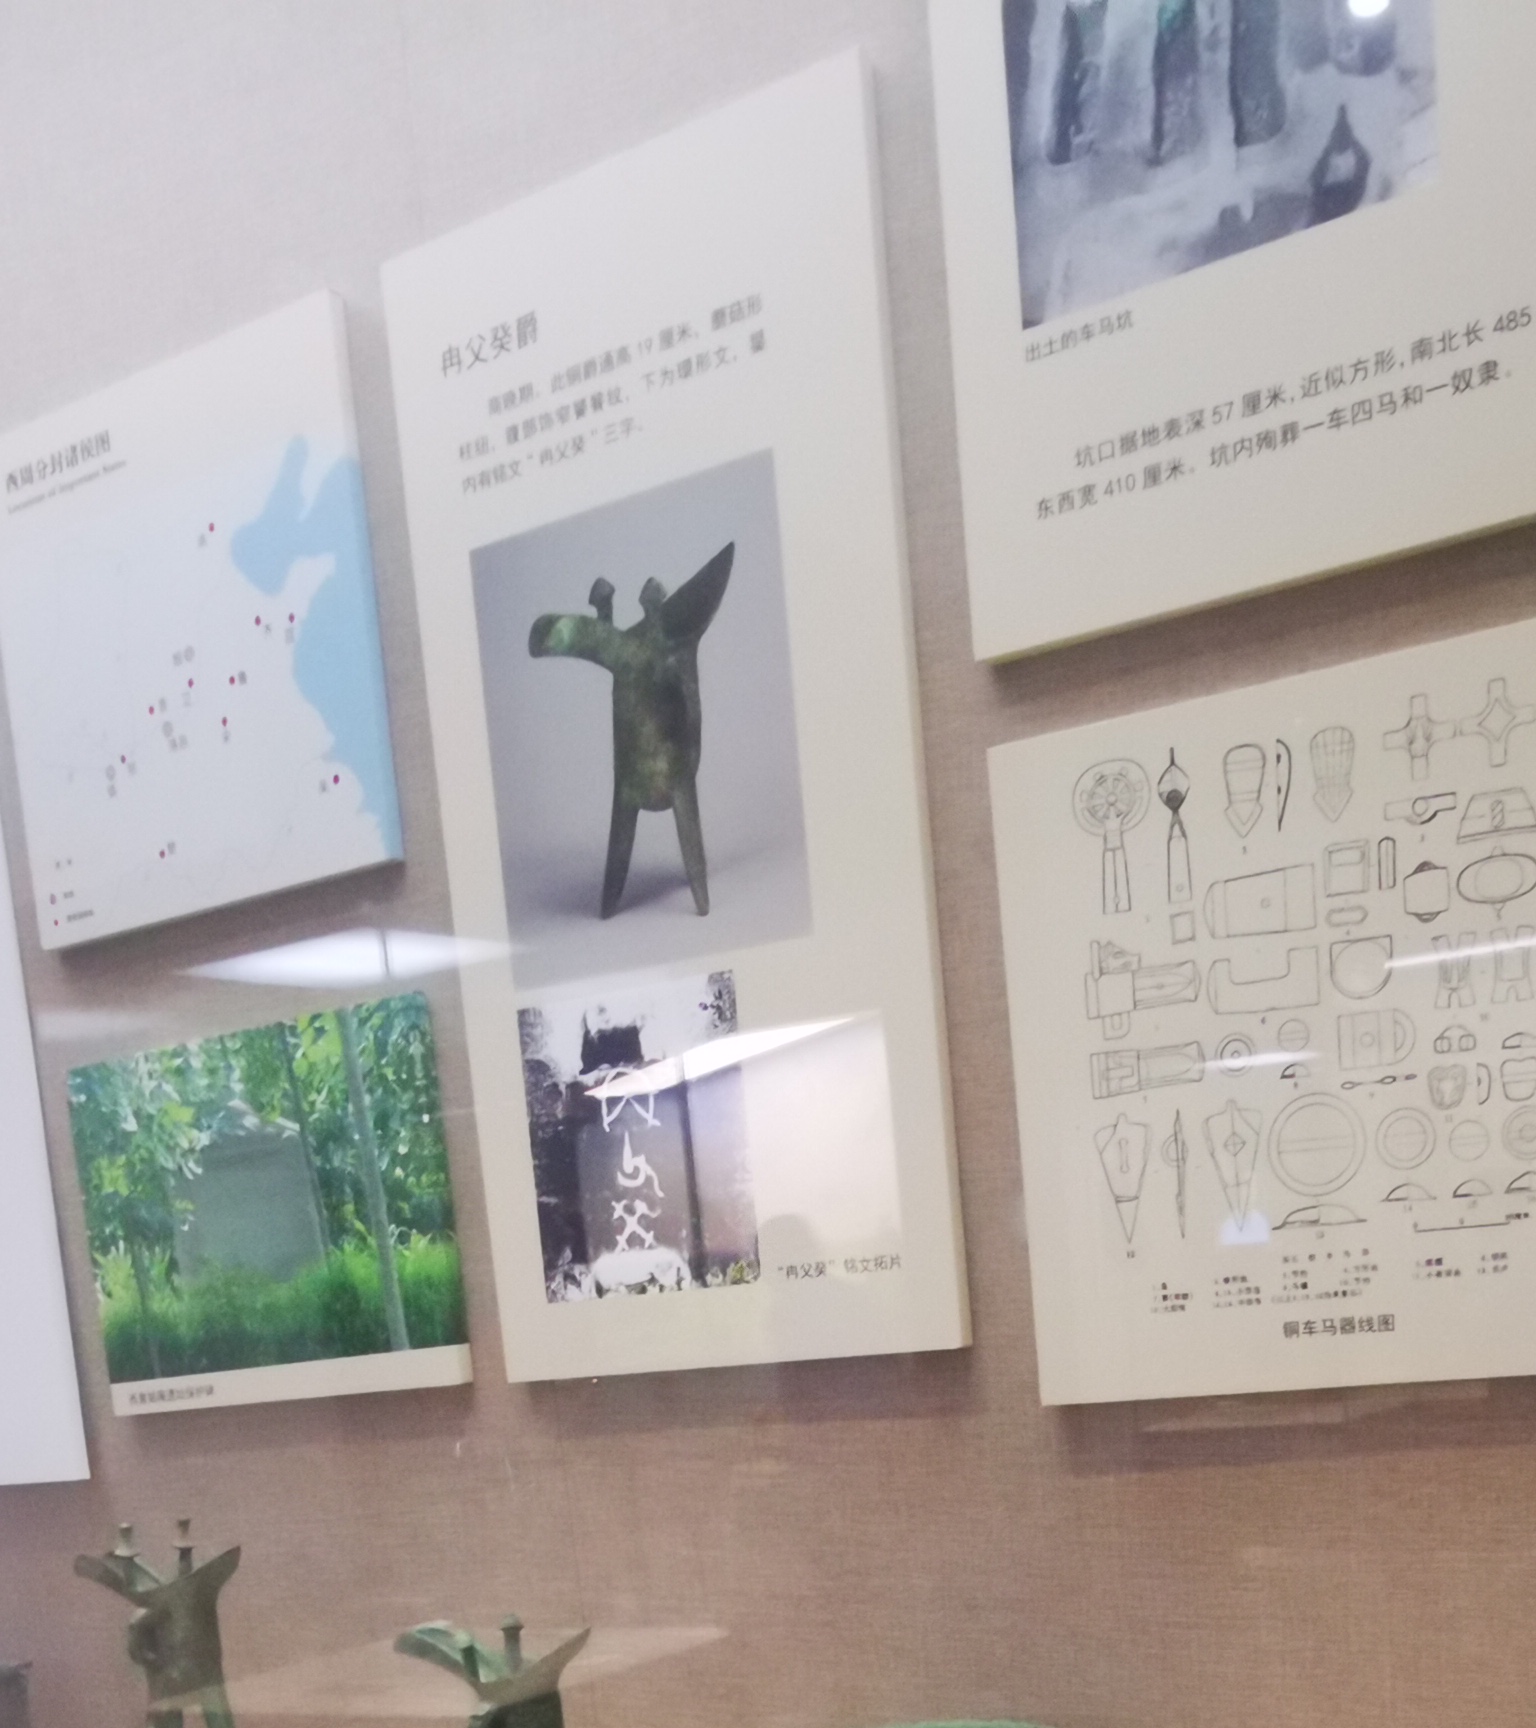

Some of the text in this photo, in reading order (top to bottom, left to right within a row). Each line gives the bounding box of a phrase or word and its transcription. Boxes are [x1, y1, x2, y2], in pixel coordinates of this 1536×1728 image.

[1493, 306, 1532, 334] 485
[1104, 473, 1137, 497] 410
[1282, 1313, 1396, 1340] 铜车马器线图
